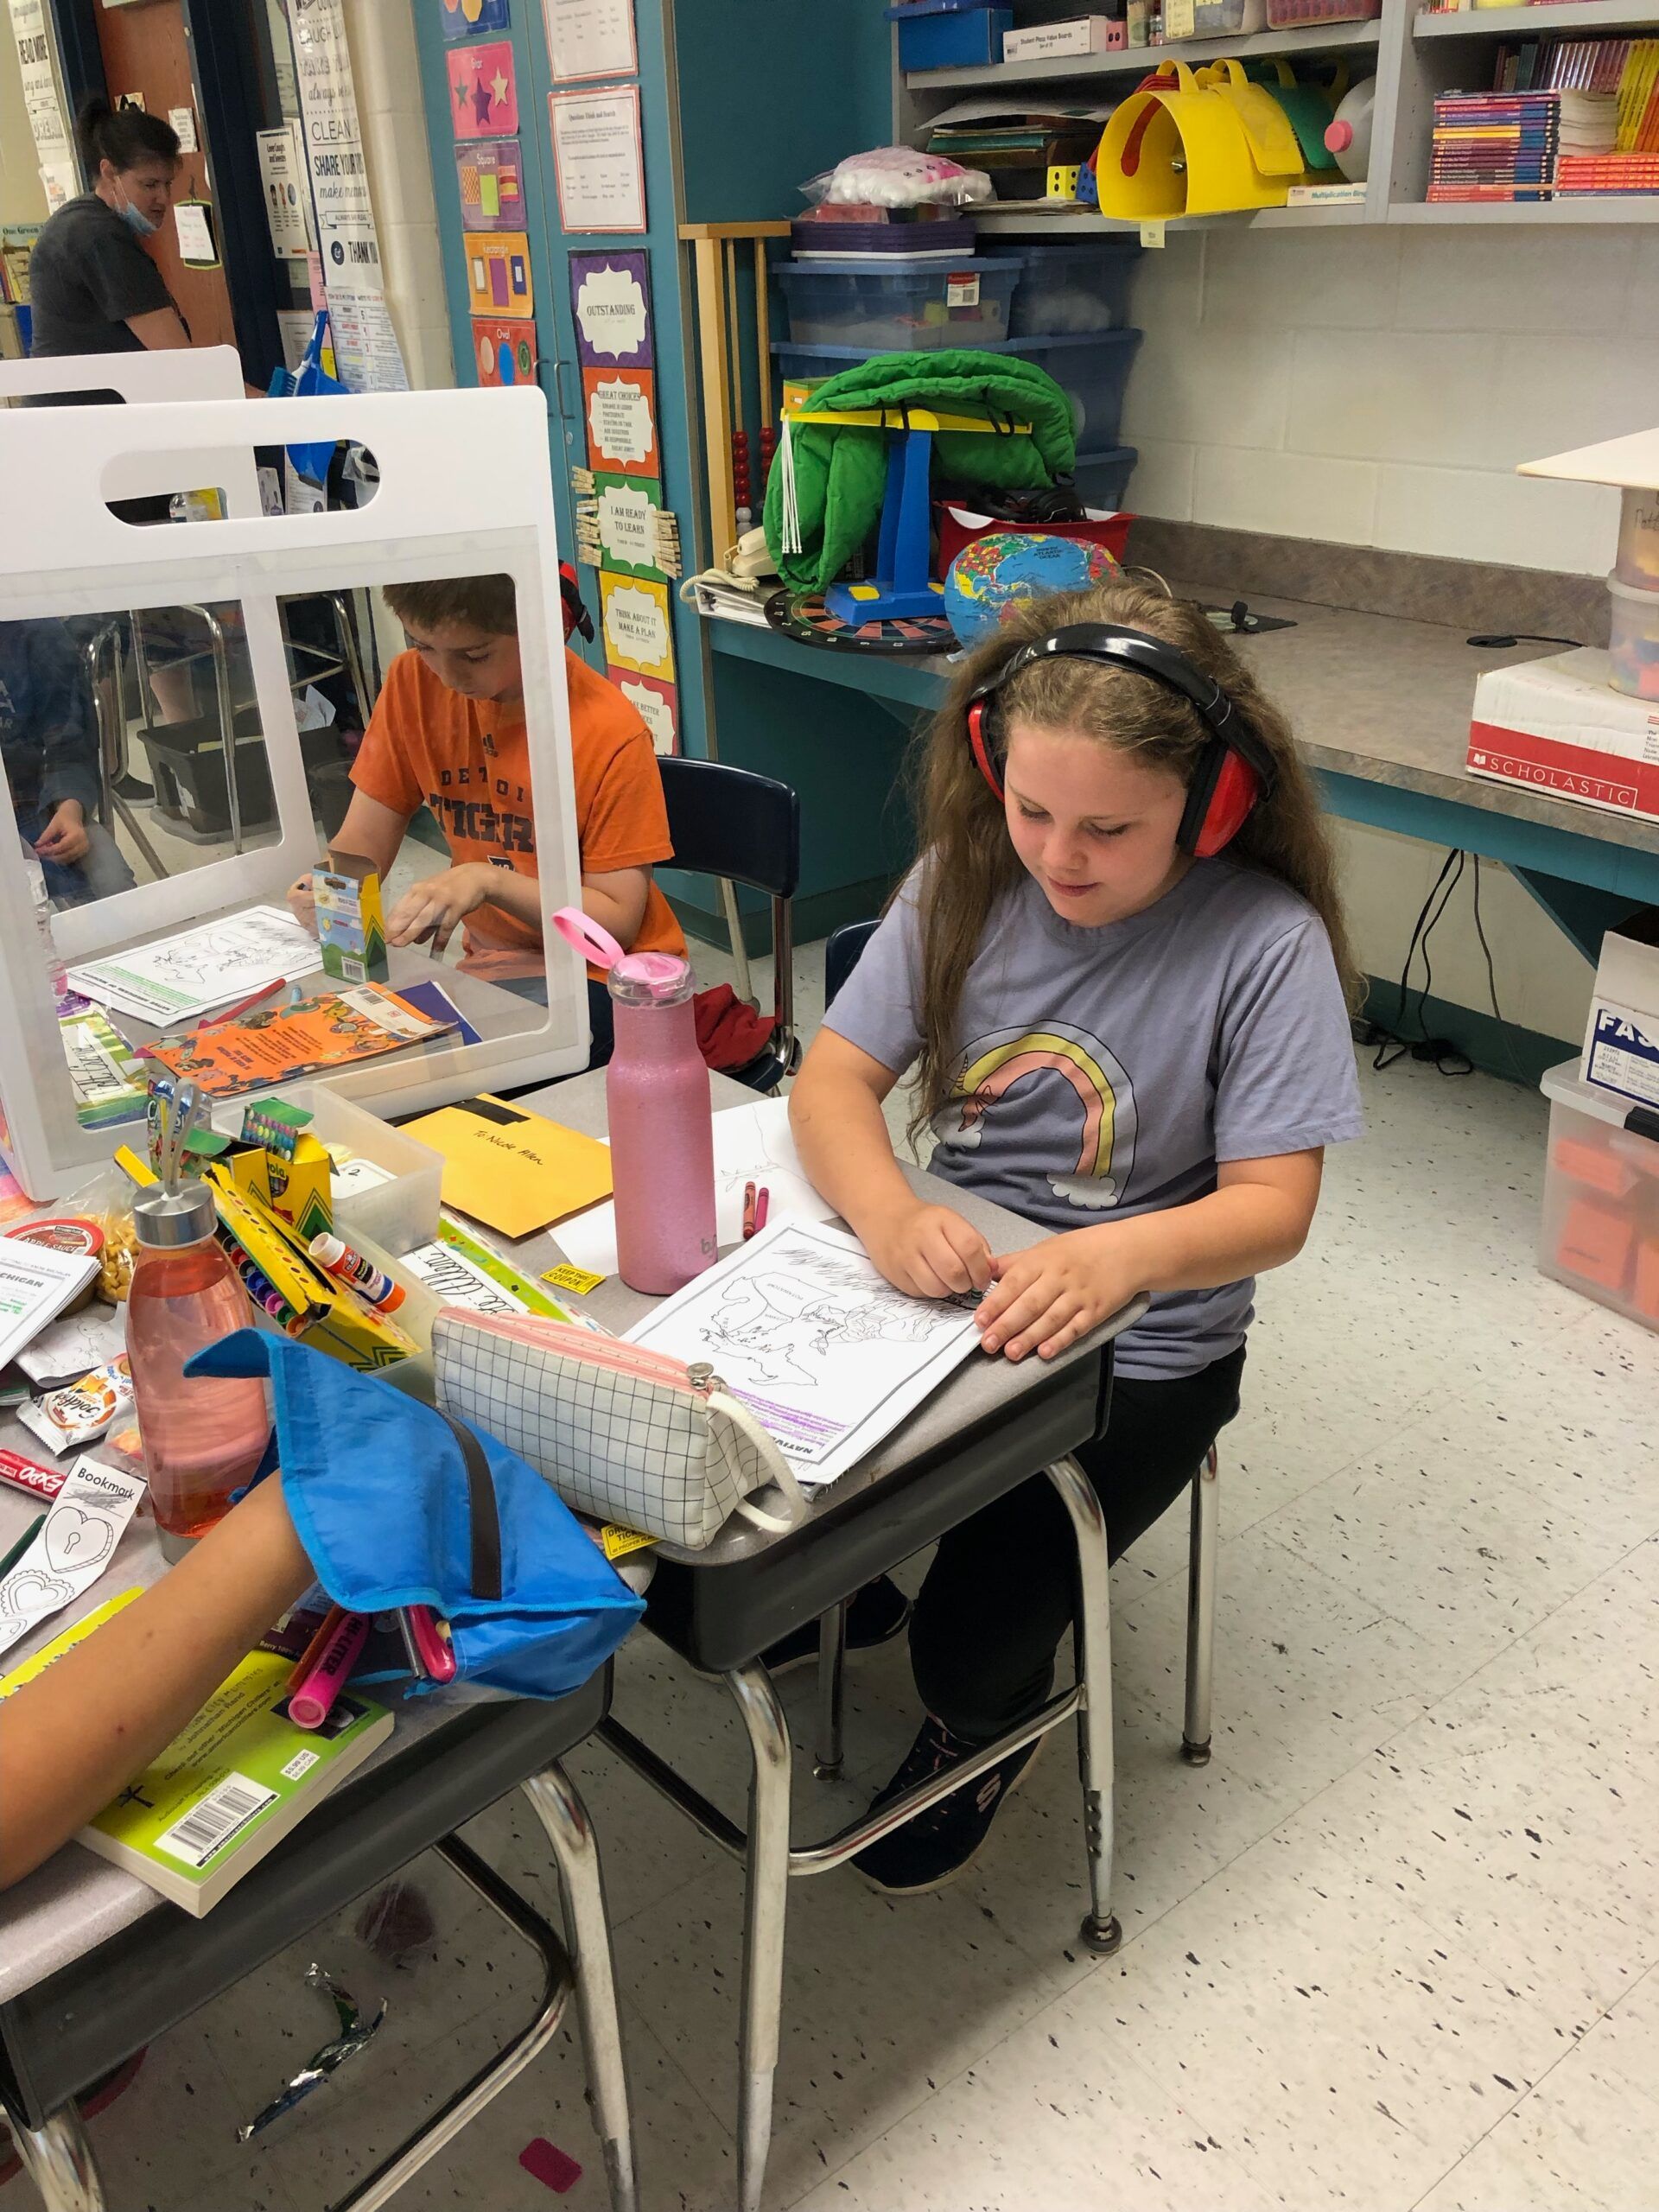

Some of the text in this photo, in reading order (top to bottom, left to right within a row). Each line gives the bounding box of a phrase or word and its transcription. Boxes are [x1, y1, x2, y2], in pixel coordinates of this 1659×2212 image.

[311, 119, 351, 142] CLEAN
[314, 154, 341, 176] SHARE
[340, 152, 356, 175] YOUR
[476, 154, 496, 167] Square
[320, 181, 344, 199] make
[1312, 190, 1352, 200] Multiplication
[348, 241, 370, 264] THANK
[587, 304, 636, 317] OUTSTANDING
[496, 328, 511, 340] Oval
[599, 391, 640, 401] GREAT CHOICES
[614, 506, 624, 517] AM
[625, 507, 646, 520] READY
[615, 522, 645, 535] TO LEARN
[615, 608, 657, 626] THINK ABOUT IT
[618, 622, 635, 633] MAKE
[641, 626, 656, 639] PLAN
[640, 702, 660, 716] BETTER
[1490, 758, 1630, 804] SCHOLASTIC
[518, 1149, 543, 1166] Allen
[23, 1236, 79, 1254] APPLE SAUCE
[0, 1270, 44, 1287] CHIGAN
[548, 1272, 582, 1287] COUPON
[557, 1267, 589, 1281] KEEP THIS
[52, 1391, 101, 1419] Goldfish
[774, 1437, 813, 1454] NATIV
[19, 1466, 64, 1493] EXPO
[77, 1467, 136, 1501] Bookmark
[619, 1541, 640, 1550] PROPER
[259, 1640, 276, 1650] Berry
[318, 1616, 364, 1677] HI-LITER
[188, 1708, 226, 1744] Johnathan
[225, 1692, 246, 1709] Rand
[164, 1762, 187, 1781] Check
[187, 1750, 198, 1763] out
[198, 1734, 215, 1751] other
[299, 1751, 309, 1762] US
